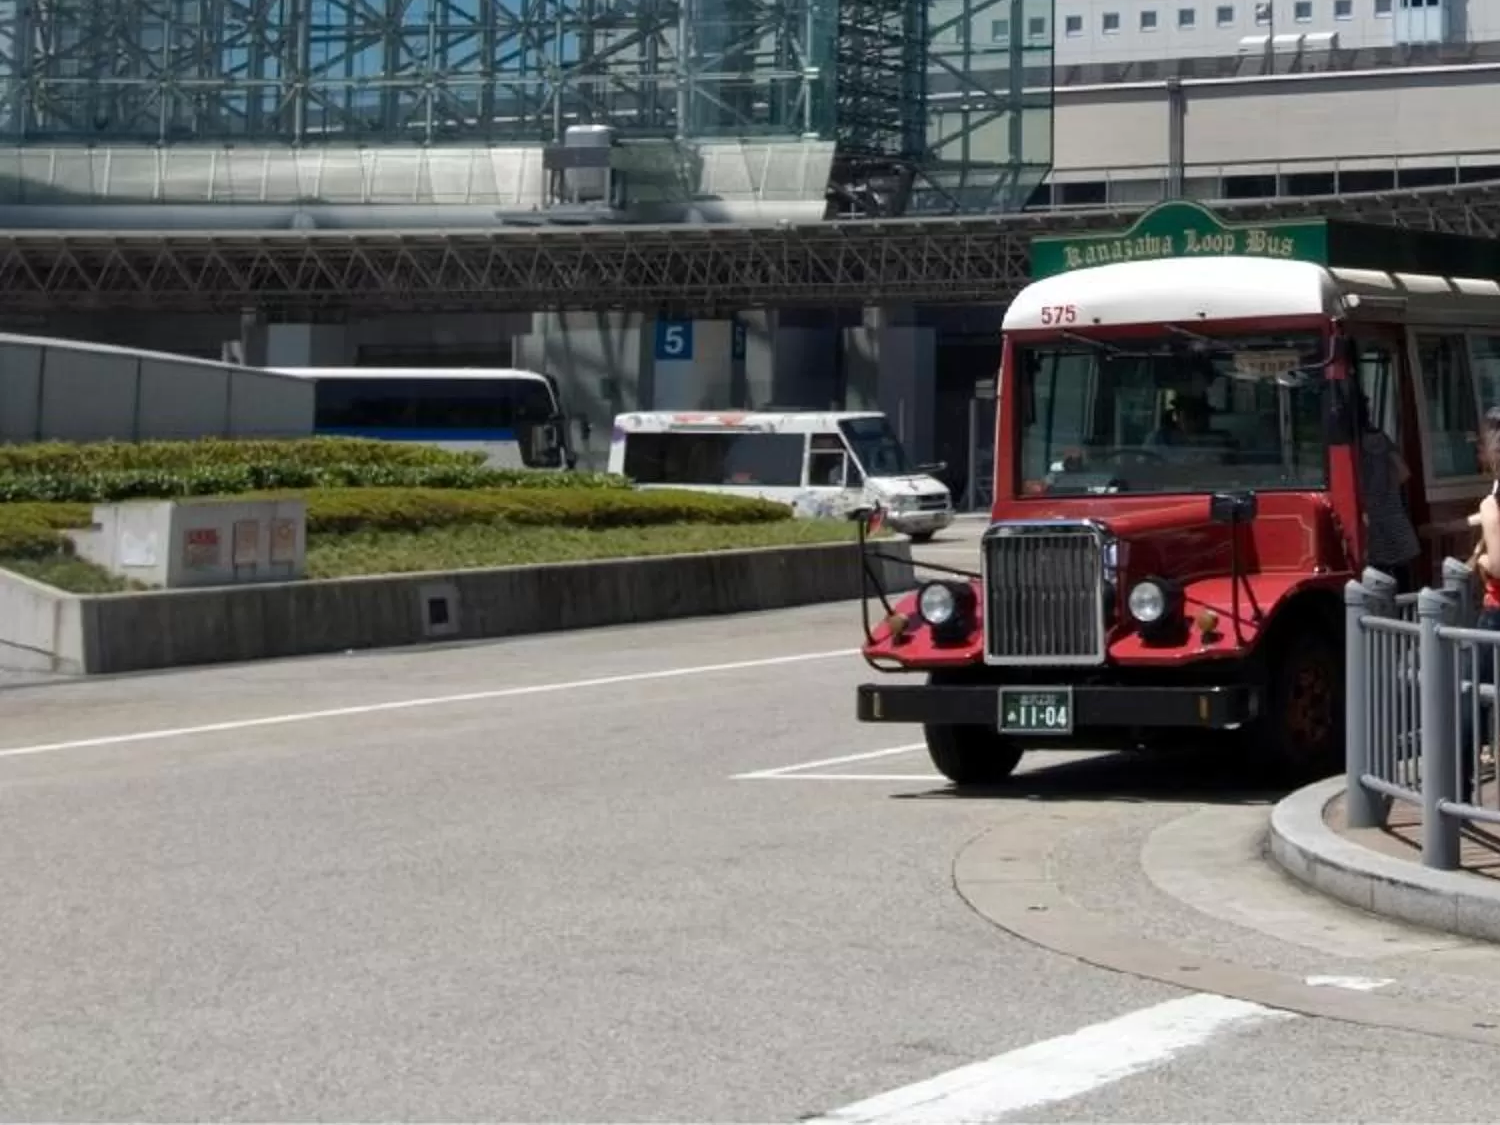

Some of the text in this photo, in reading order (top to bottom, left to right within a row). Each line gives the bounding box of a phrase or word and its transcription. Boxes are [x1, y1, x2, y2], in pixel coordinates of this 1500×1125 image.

[1063, 229, 1295, 268] Kanazawa Loop Bus
[1041, 304, 1077, 324] 575
[663, 325, 685, 354] 5
[1020, 706, 1067, 727] 11-04
